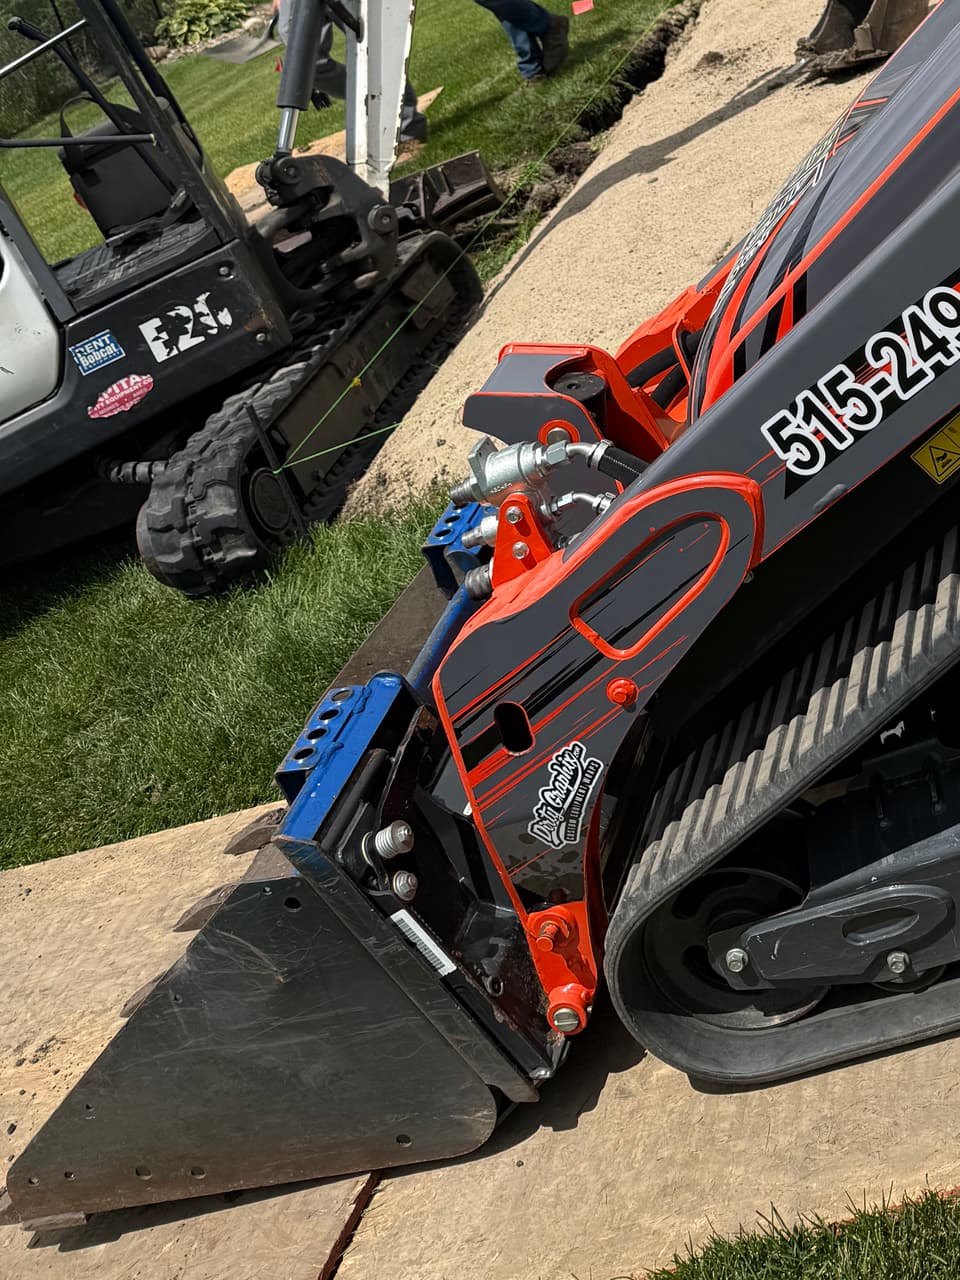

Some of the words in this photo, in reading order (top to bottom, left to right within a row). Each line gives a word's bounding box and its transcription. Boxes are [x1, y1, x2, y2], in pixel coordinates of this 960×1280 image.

[75, 336, 111, 358] RENT
[78, 342, 117, 367] Bobcat
[584, 762, 599, 783] WRAPS
[570, 785, 588, 818] EQUIPMENT
[532, 805, 564, 841] Dirty
[566, 819, 577, 840] CUSTOM
